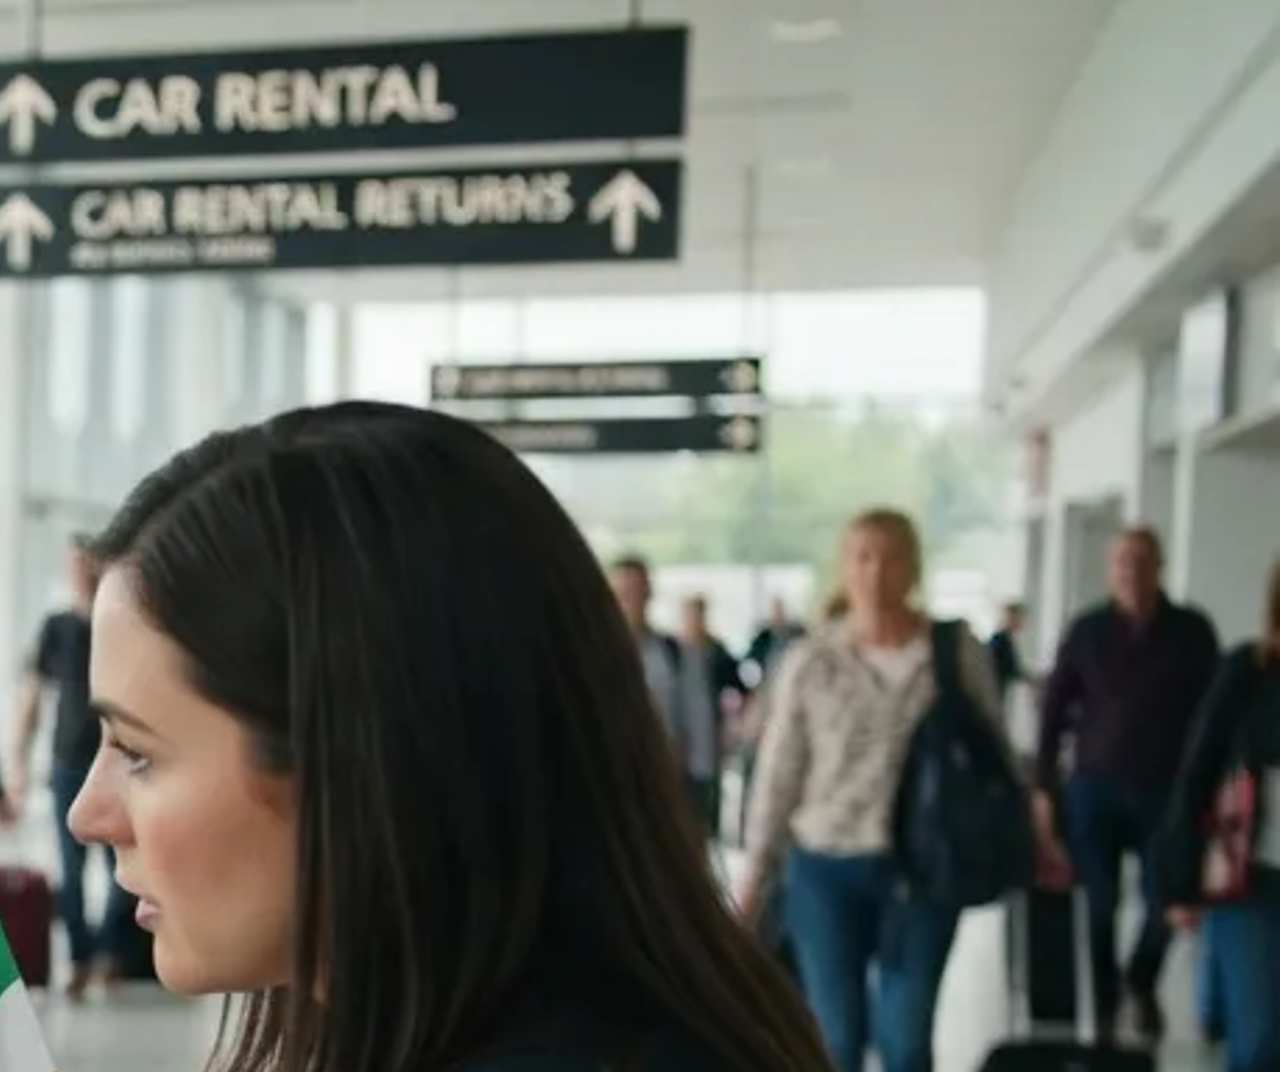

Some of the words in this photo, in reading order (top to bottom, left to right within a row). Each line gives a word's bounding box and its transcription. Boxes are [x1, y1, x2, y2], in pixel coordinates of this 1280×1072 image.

[73, 74, 202, 139] CAR
[214, 62, 457, 133] RENTAL
[70, 188, 167, 239] CAR
[172, 181, 349, 233] RENTAL
[354, 170, 574, 229] RETURNS
